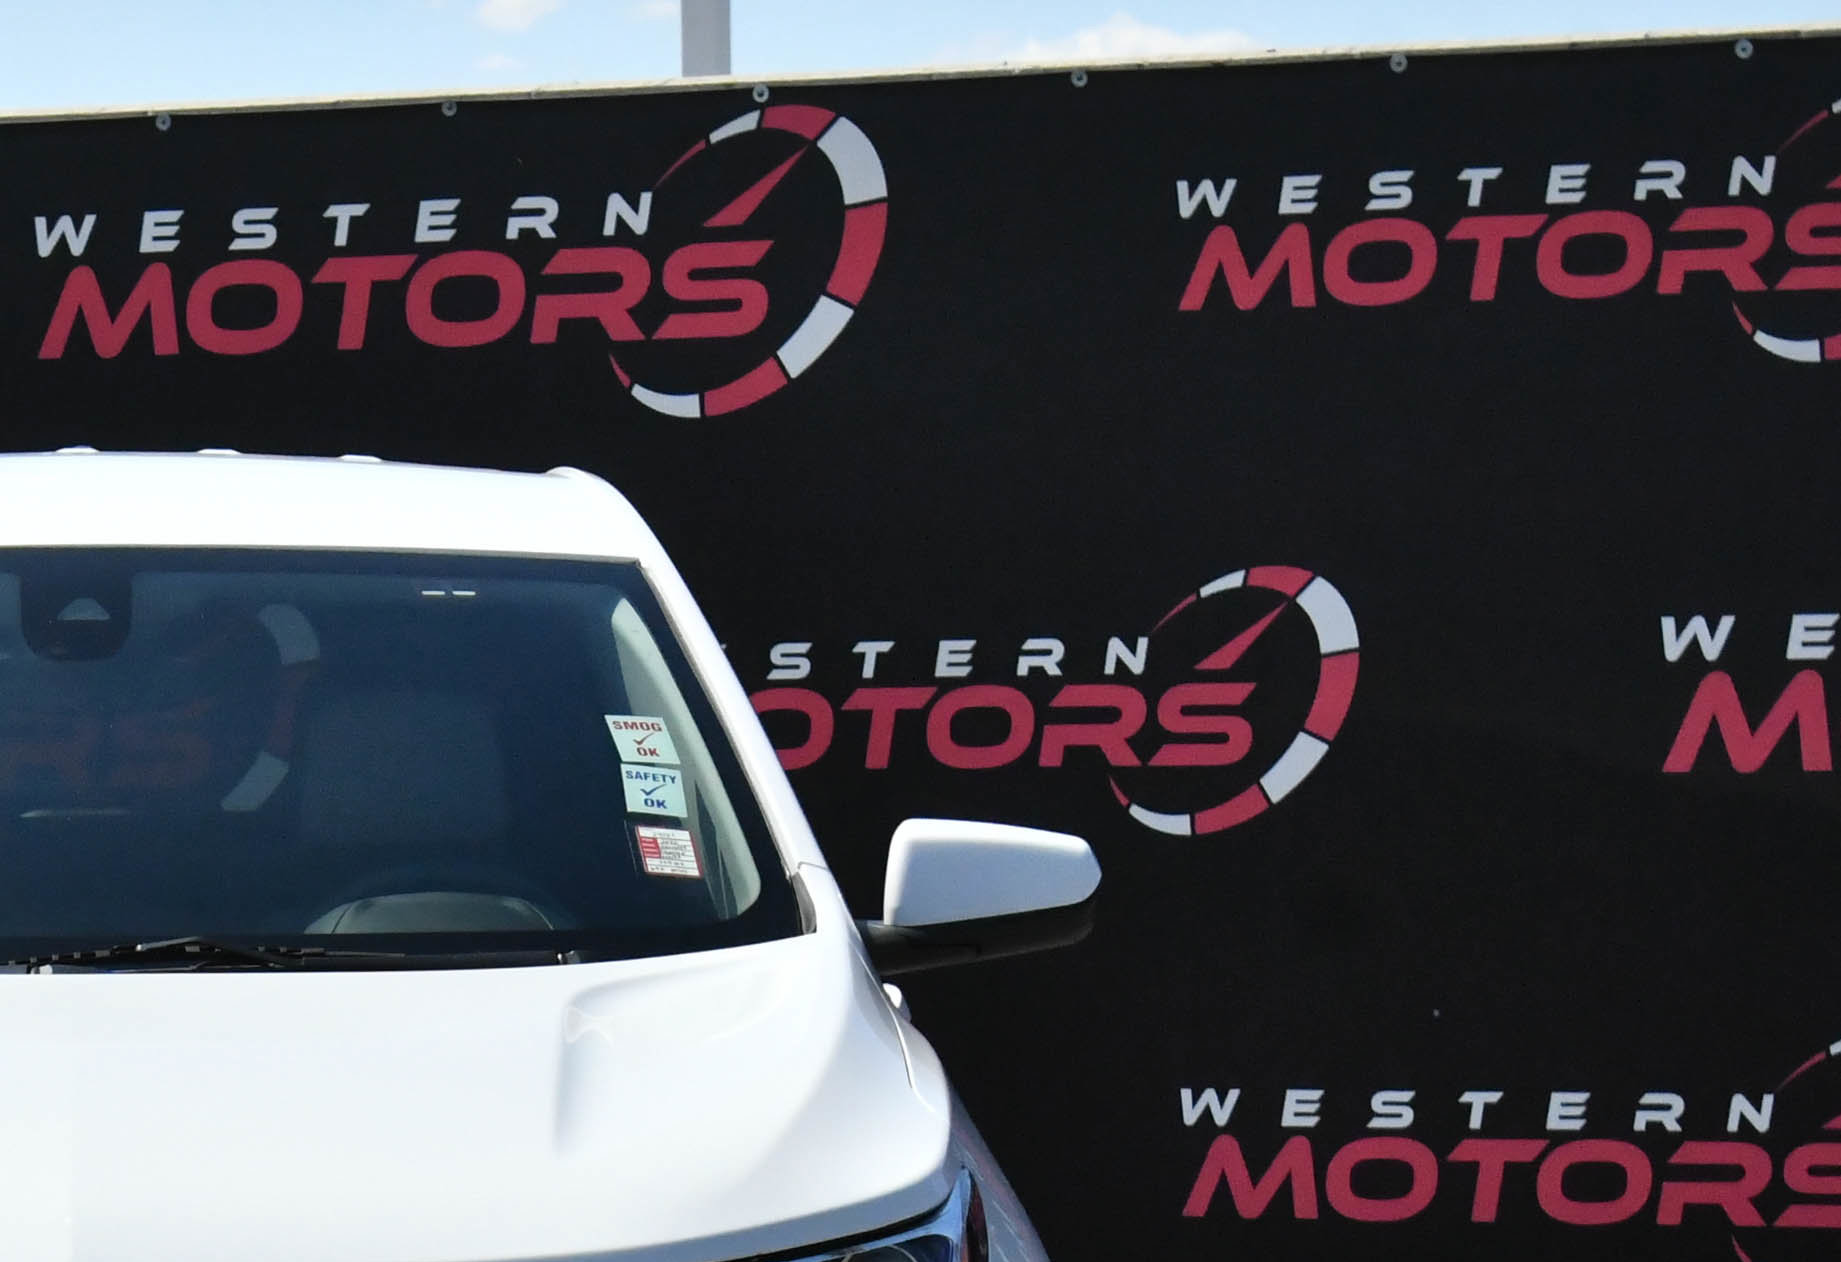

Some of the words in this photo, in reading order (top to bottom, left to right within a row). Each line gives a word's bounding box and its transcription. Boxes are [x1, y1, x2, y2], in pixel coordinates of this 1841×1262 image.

[1176, 155, 1777, 219] WESTERN
[34, 191, 653, 258] WESTERN
[39, 239, 773, 359] MOTORS
[722, 636, 1150, 680] STERN
[1660, 613, 1841, 663] WE
[611, 720, 663, 732] SMOG
[636, 747, 660, 757] OK
[625, 770, 677, 784] SAFETY
[643, 798, 668, 809] OK
[1180, 1087, 1774, 1133] WESTERN
